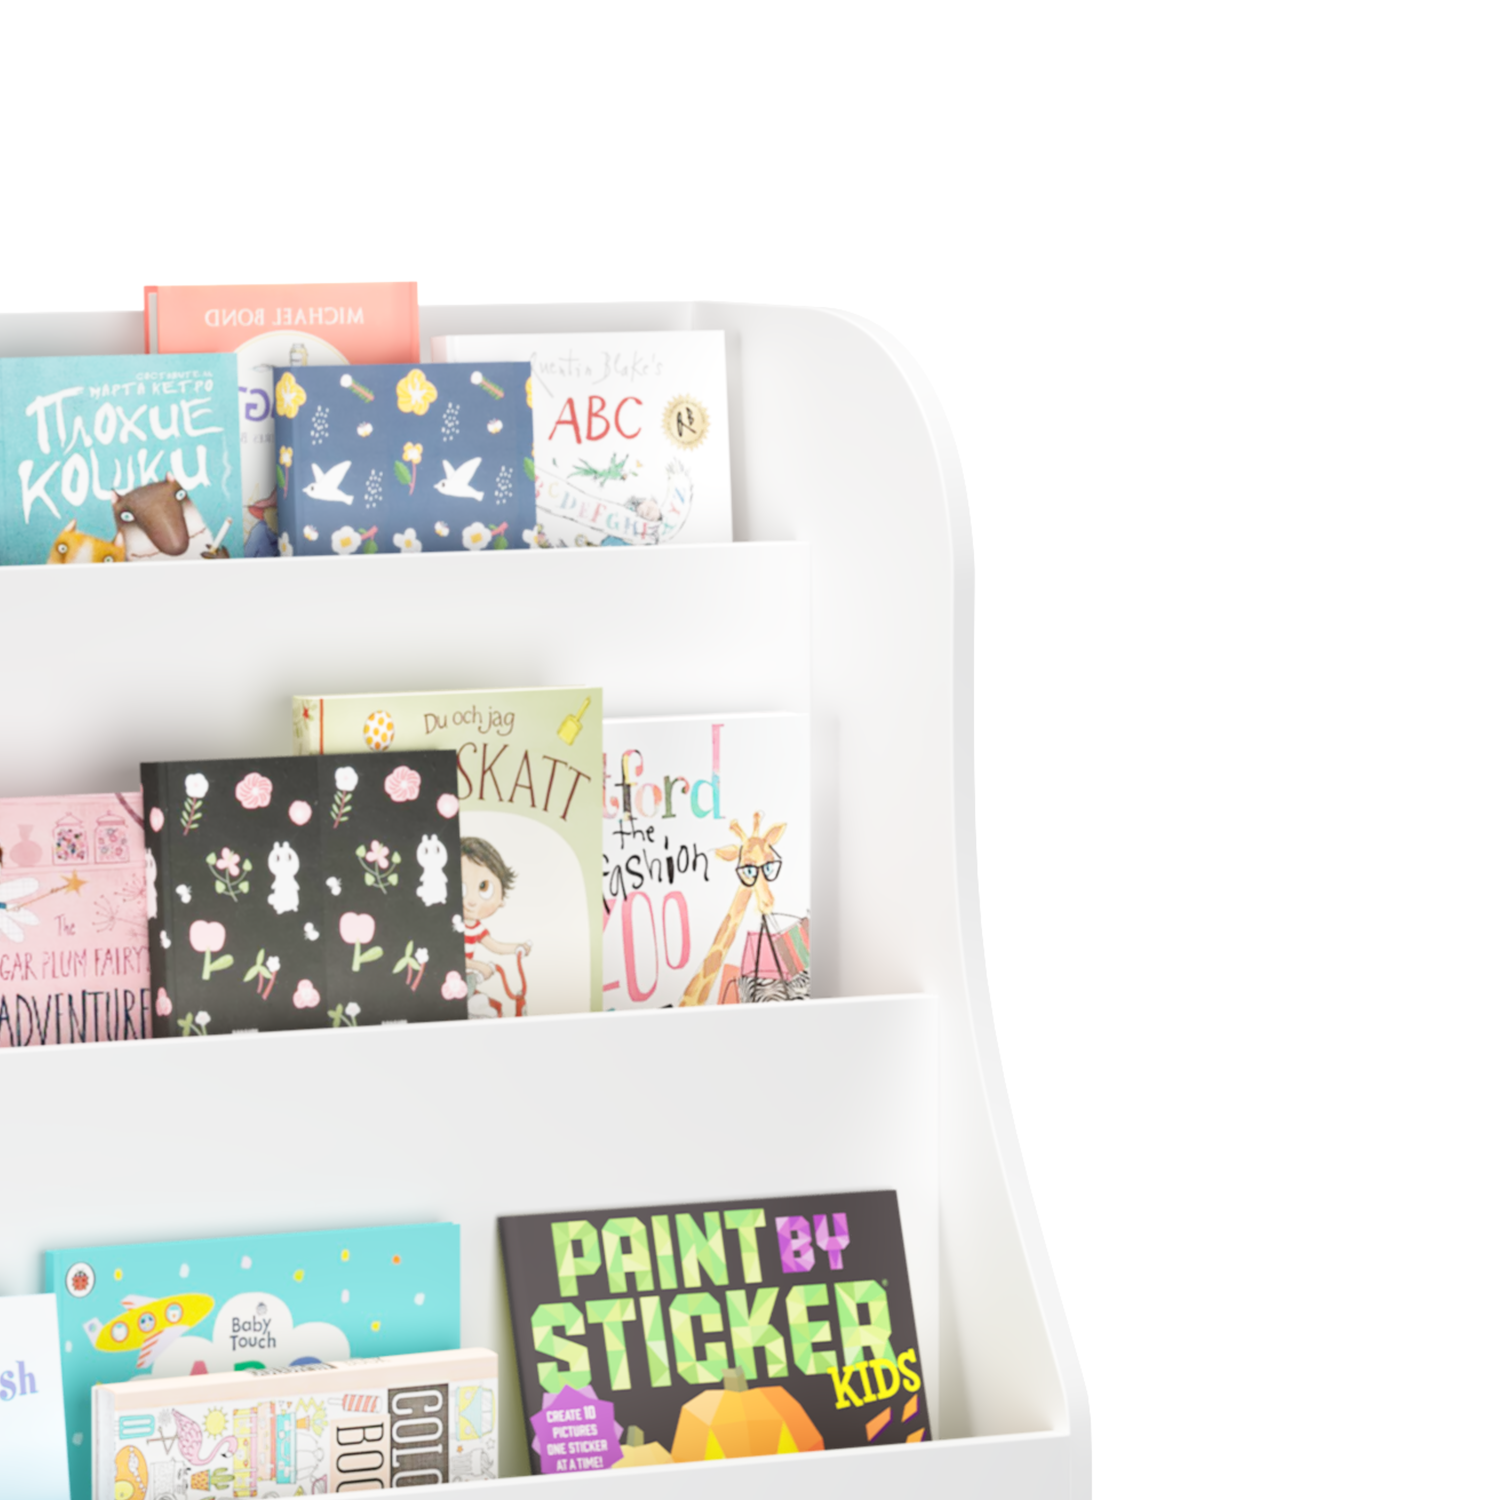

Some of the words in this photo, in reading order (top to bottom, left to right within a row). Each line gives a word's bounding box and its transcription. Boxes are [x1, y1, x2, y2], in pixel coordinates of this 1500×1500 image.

[90, 381, 146, 399] МАРТА
[152, 379, 214, 396] КЕТРО
[548, 395, 643, 444] ABC
[424, 712, 447, 734] Du
[452, 705, 482, 725] och
[478, 706, 515, 736] jag
[457, 741, 591, 822] SKATT
[602, 724, 726, 820] tford
[612, 817, 655, 850] the
[55, 914, 76, 936] The
[42, 948, 87, 979] PLUM
[94, 946, 150, 976] FAIRY
[551, 1208, 766, 1297] PAINT
[775, 1212, 850, 1273] BY
[229, 1331, 276, 1351] Touch
[232, 1315, 271, 1335] Baby
[827, 1348, 921, 1410] KIDS
[546, 1408, 582, 1423] CREATE
[583, 1405, 596, 1420] 10
[392, 1389, 443, 1487] COLO
[552, 1423, 598, 1439] PICTURES
[336, 1422, 384, 1492] BOO
[546, 1442, 567, 1456] ONE
[568, 1439, 608, 1454] STICKER
[556, 1459, 567, 1472] AT
[569, 1458, 577, 1471] A
[577, 1456, 604, 1470] TIME!
